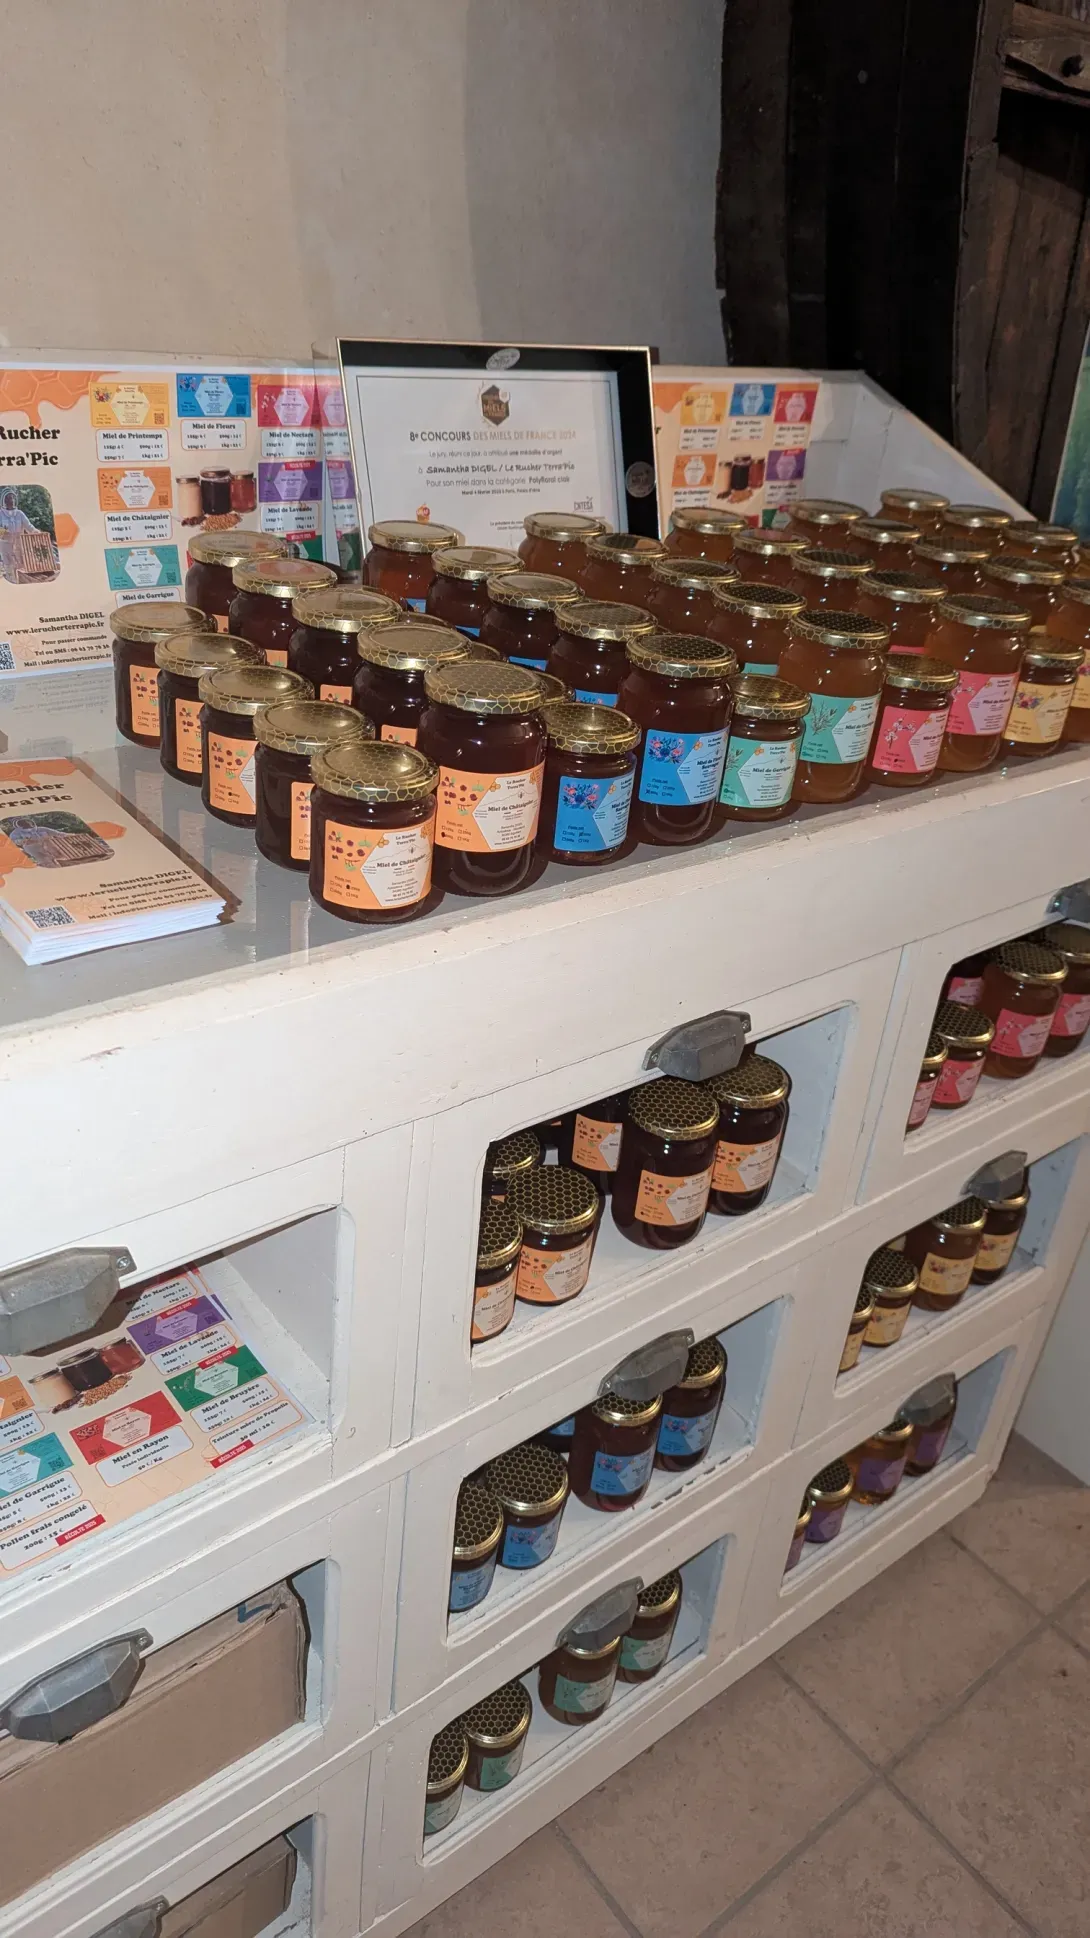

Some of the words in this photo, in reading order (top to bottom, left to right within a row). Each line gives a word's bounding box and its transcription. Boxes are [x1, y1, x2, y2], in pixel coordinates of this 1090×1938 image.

[420, 431, 471, 441] CONCOURS
[474, 432, 488, 441] DES
[490, 431, 512, 440] MIELS
[514, 431, 524, 440] DE
[526, 431, 556, 440] FRANCE
[426, 465, 469, 474] Samantha
[456, 478, 469, 486] miel
[471, 478, 486, 486] dans
[488, 477, 494, 486] la
[39, 612, 78, 623] Samantha
[80, 612, 105, 620] DIGEL
[6, 621, 104, 636] www.lerucherterrapic.fr
[0, 784, 64, 795] ucher
[100, 875, 154, 888] Samantha
[155, 869, 190, 878] DIGEL
[152, 1282, 180, 1295] Nectars
[161, 1348, 178, 1358] Miel
[188, 1330, 218, 1345] Lavande
[201, 1403, 219, 1414] Miel
[229, 1384, 260, 1400] Bruyère
[212, 1428, 239, 1444] Teinture
[240, 1420, 255, 1429] mère
[264, 1402, 289, 1417] Propolis
[112, 1452, 131, 1464] Miel
[143, 1435, 169, 1450] Rayon
[122, 1460, 137, 1469] Pesée
[137, 1444, 169, 1461] individuelle
[218, 1450, 236, 1462] RÉCOLTE
[236, 1445, 247, 1453] 2025
[24, 1477, 65, 1498] Garrigue
[40, 1493, 55, 1502] 500g
[0, 1532, 30, 1550] Pollen
[30, 1523, 52, 1535] frais
[54, 1504, 87, 1524] congelé
[64, 1527, 85, 1540] RÉCOLTE
[86, 1520, 97, 1528] 2025
[24, 1540, 43, 1550] 200g
